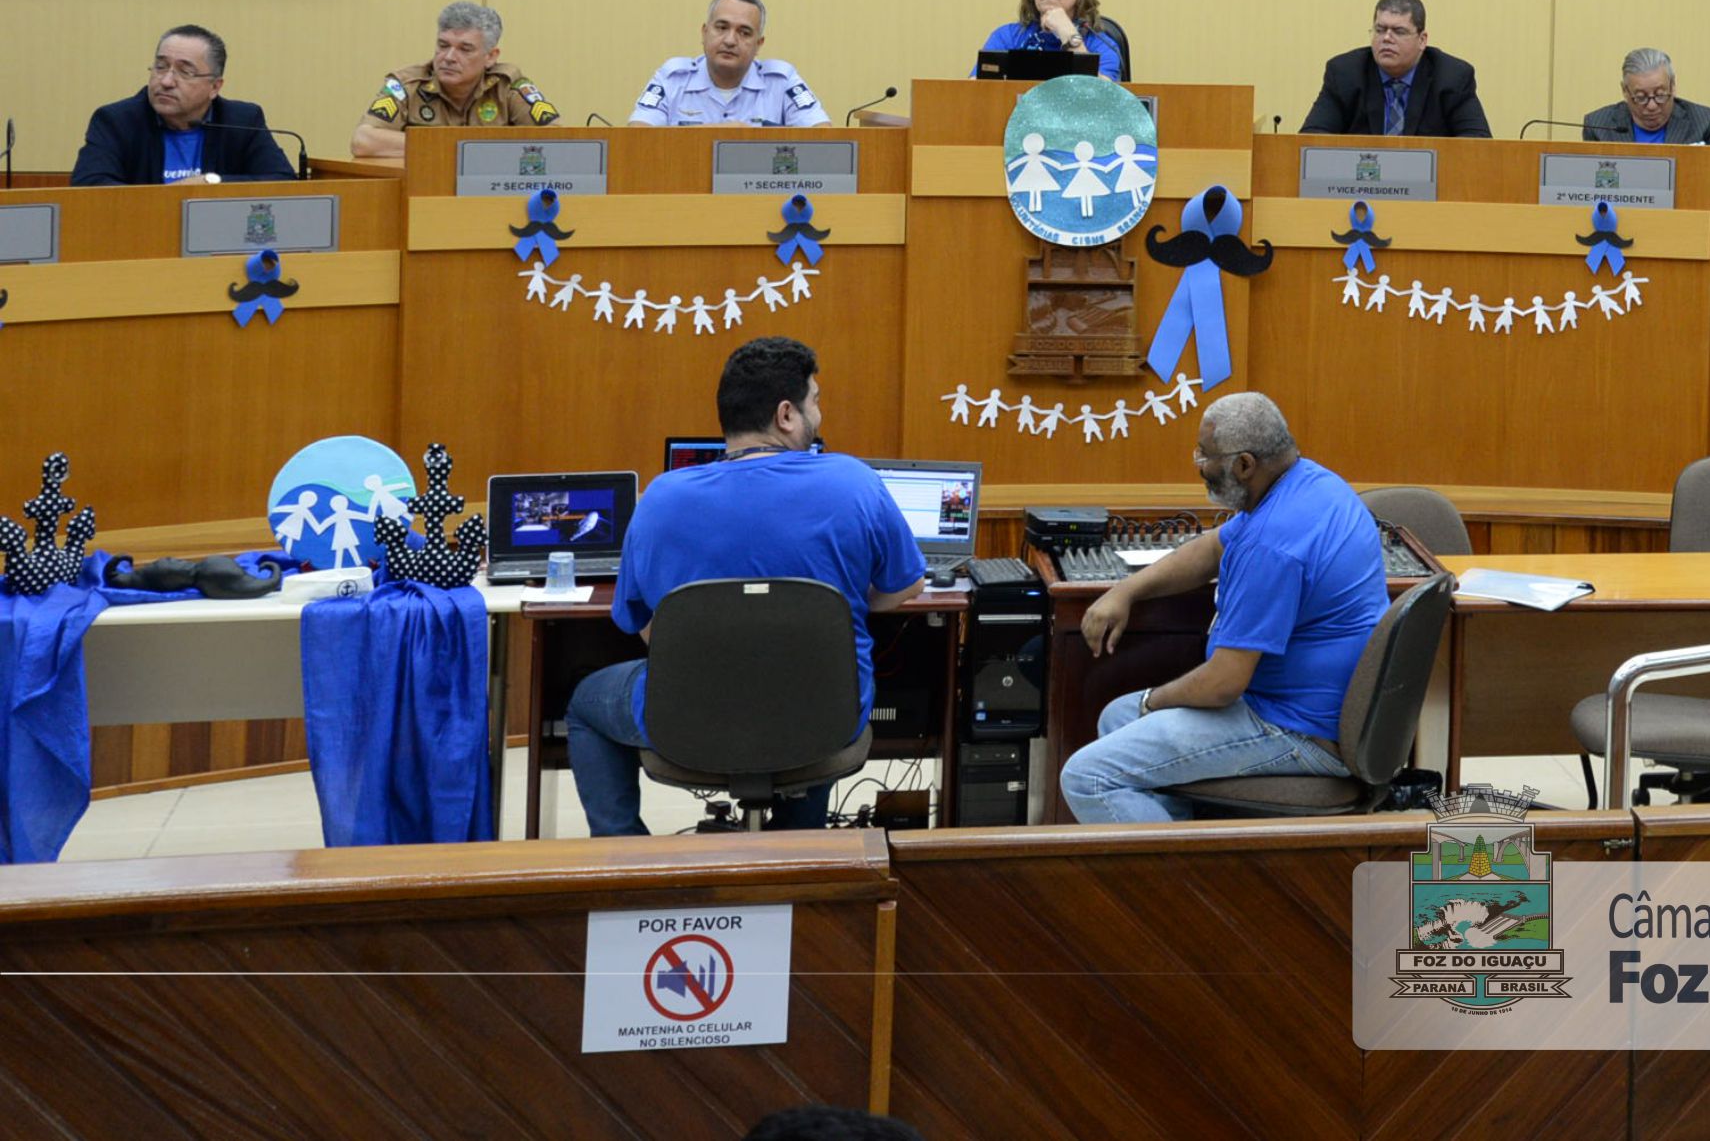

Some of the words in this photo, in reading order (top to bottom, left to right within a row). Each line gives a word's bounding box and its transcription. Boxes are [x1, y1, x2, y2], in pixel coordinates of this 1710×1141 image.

[1336, 186, 1410, 196] VICE-PRESIDENTE
[1568, 192, 1655, 204] VICE-PRESIDENTE
[638, 918, 677, 933] POR
[683, 915, 743, 932] FAVOR
[618, 1024, 684, 1037] MANTENHA
[686, 1024, 696, 1034] O
[698, 1021, 753, 1033] CELULAR
[639, 1038, 657, 1048] NO
[660, 1034, 731, 1047] SILENCIOSO
